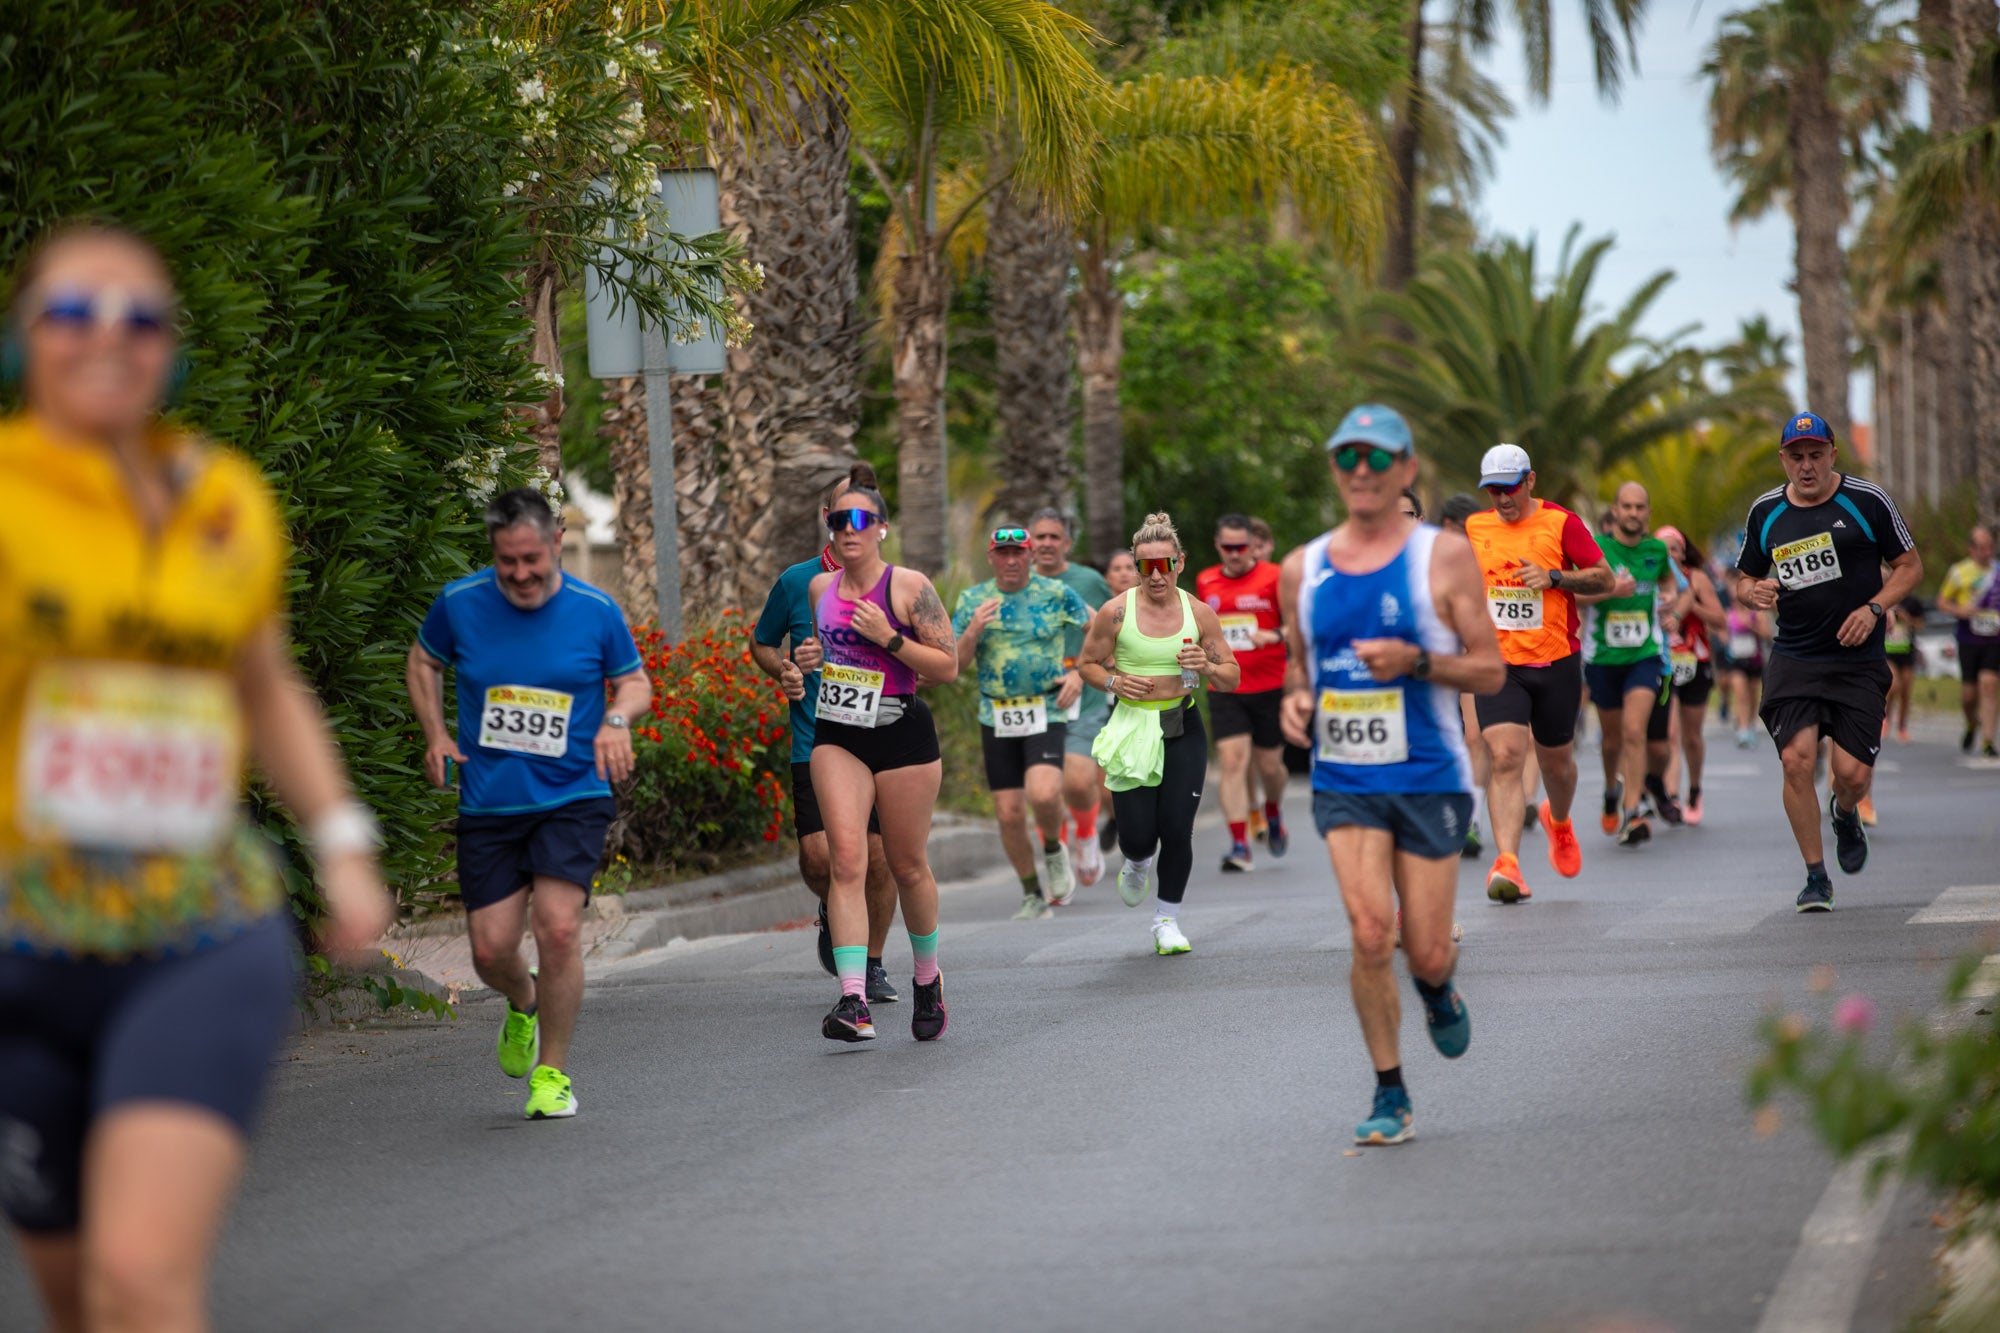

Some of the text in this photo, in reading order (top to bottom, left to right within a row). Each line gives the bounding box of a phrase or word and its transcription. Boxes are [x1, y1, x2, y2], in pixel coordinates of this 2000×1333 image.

[1780, 549, 1835, 580] 3186
[1496, 602, 1534, 619] 785
[820, 682, 875, 713] 3321
[487, 707, 564, 739] 3395
[1002, 709, 1036, 727] 631
[1327, 717, 1389, 745] 666
